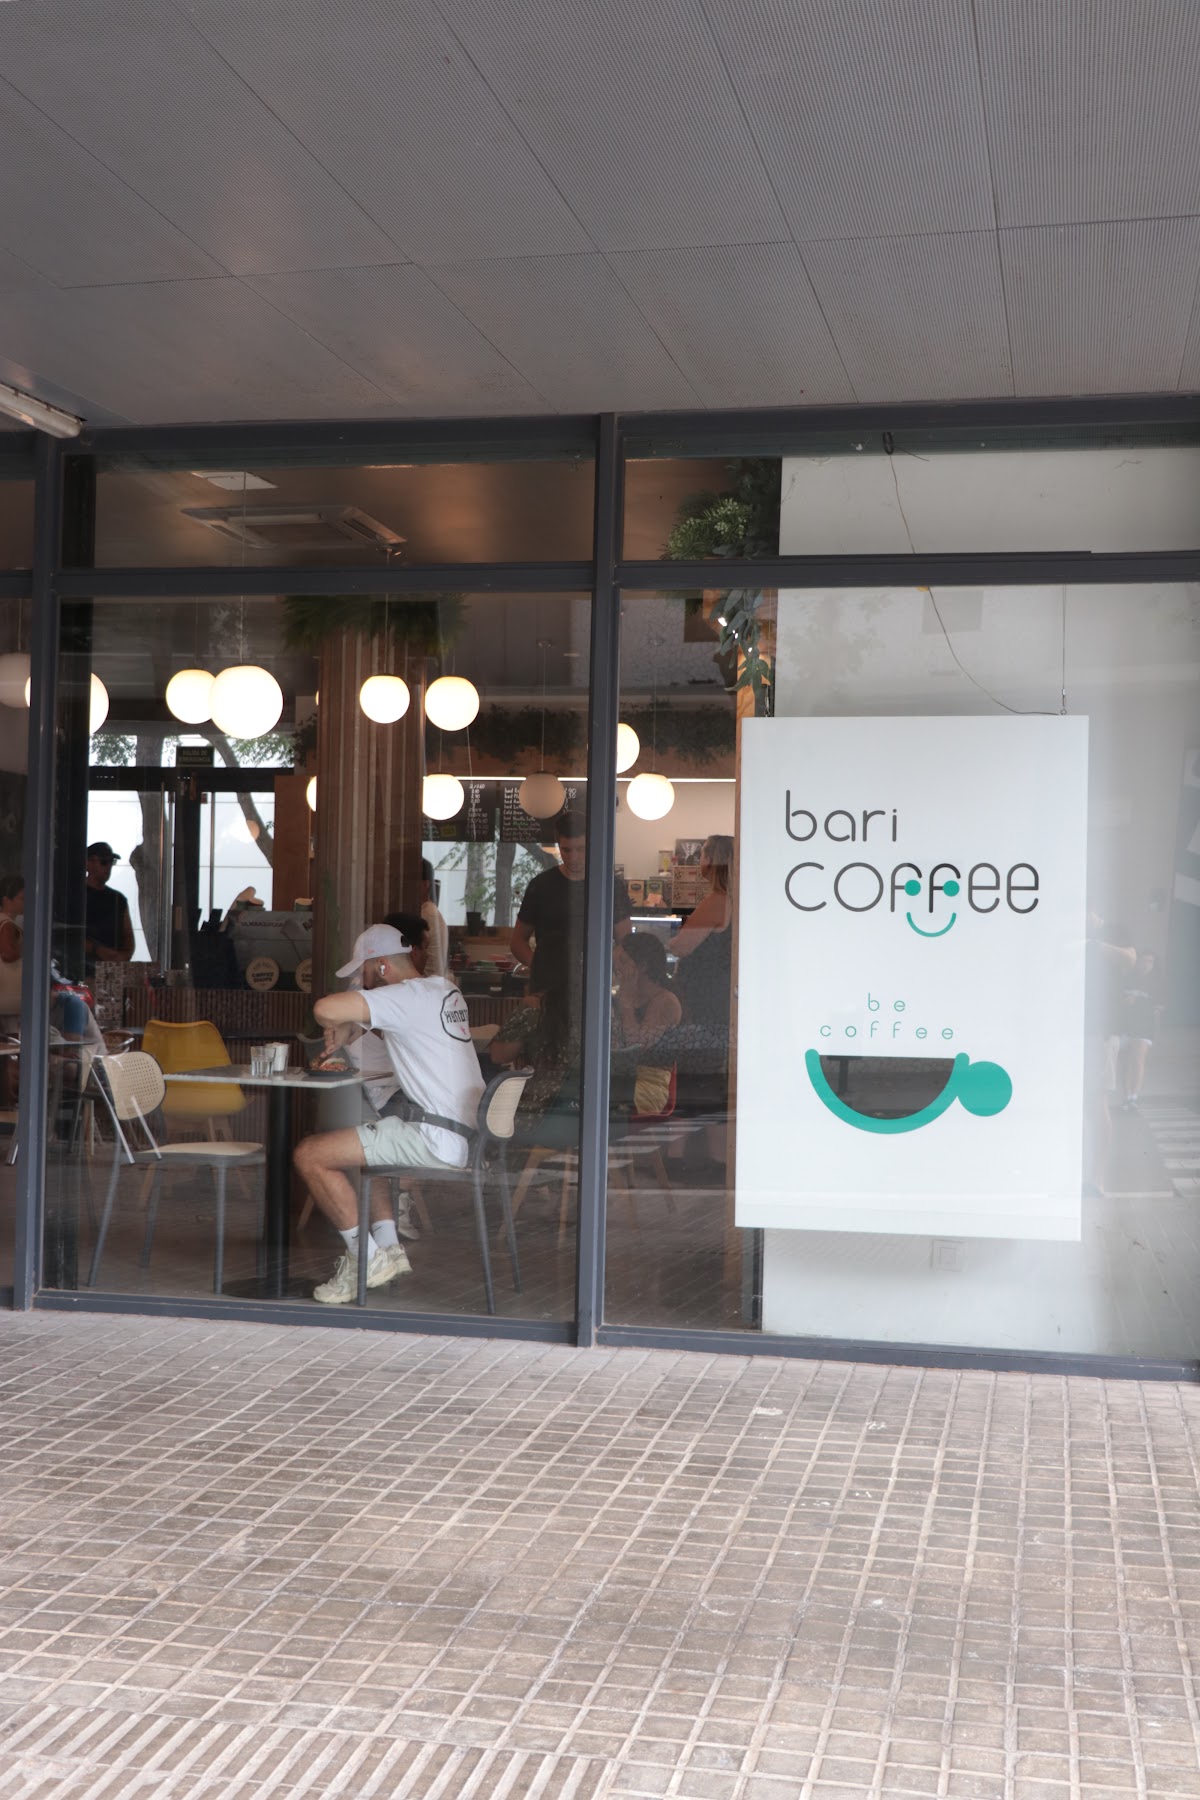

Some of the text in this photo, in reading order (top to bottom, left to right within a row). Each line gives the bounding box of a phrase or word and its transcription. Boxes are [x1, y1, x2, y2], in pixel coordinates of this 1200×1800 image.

[785, 789, 897, 842] bari
[785, 861, 1039, 914] coffee
[868, 992, 905, 1012] be
[820, 1020, 953, 1040] coffee
